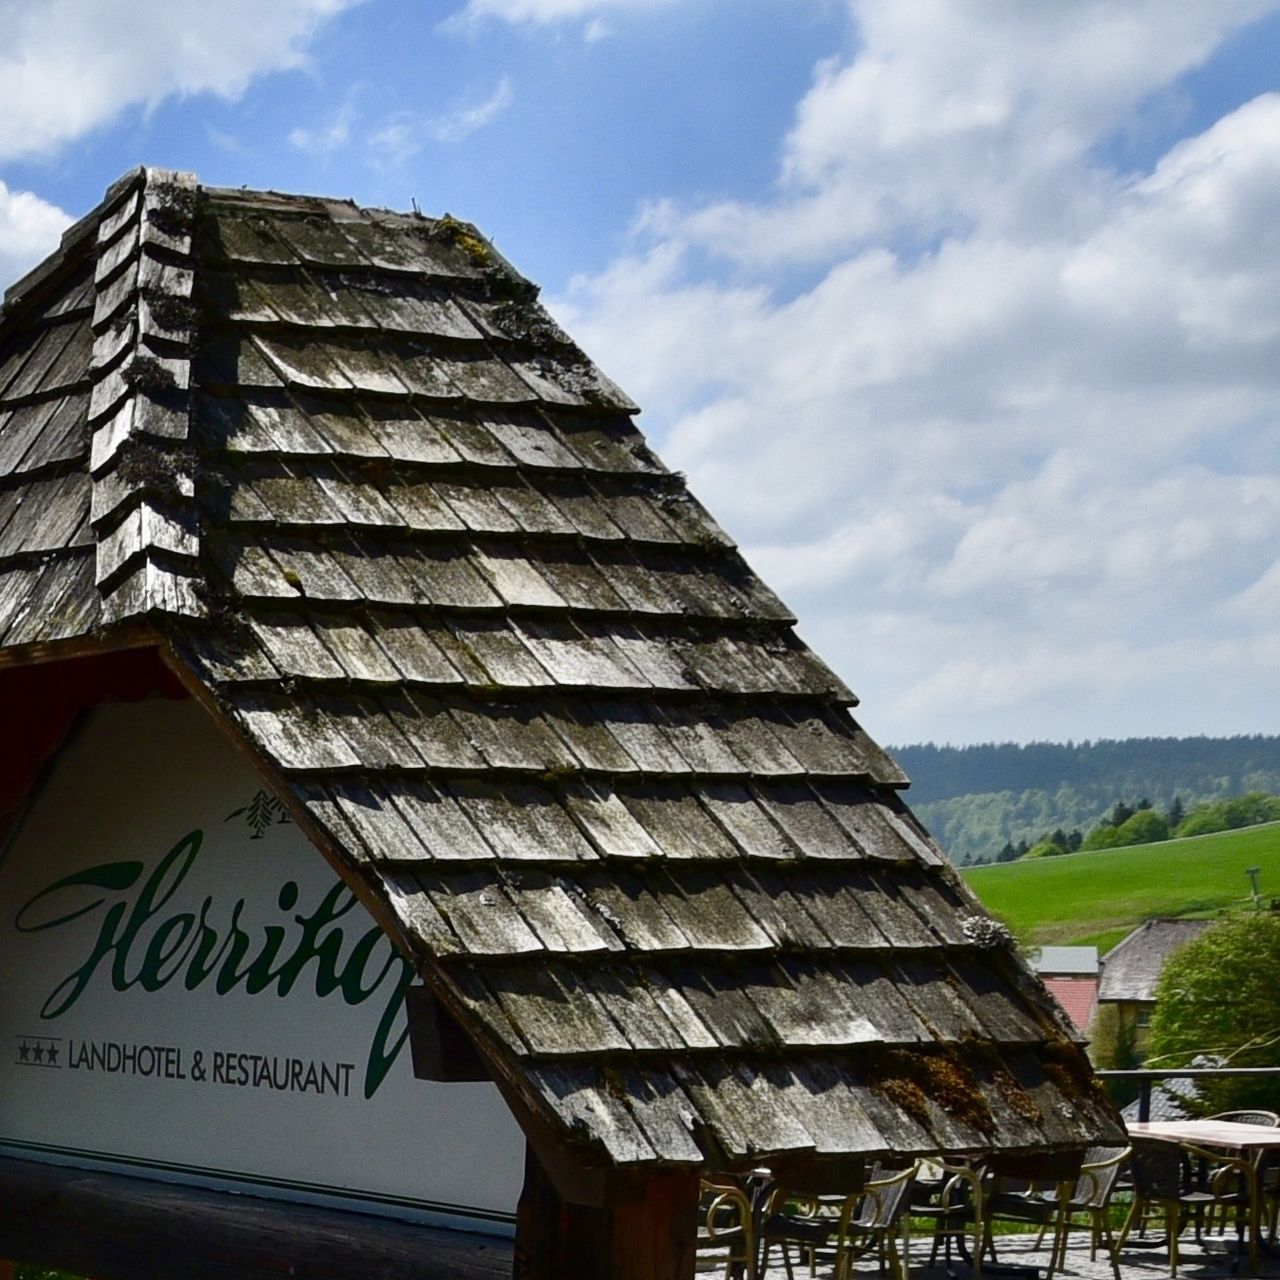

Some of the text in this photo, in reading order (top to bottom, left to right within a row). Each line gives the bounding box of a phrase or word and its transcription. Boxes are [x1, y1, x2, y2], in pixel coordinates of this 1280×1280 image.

[68, 1039, 355, 1097] LANDHOTEL & RESTAURANT
